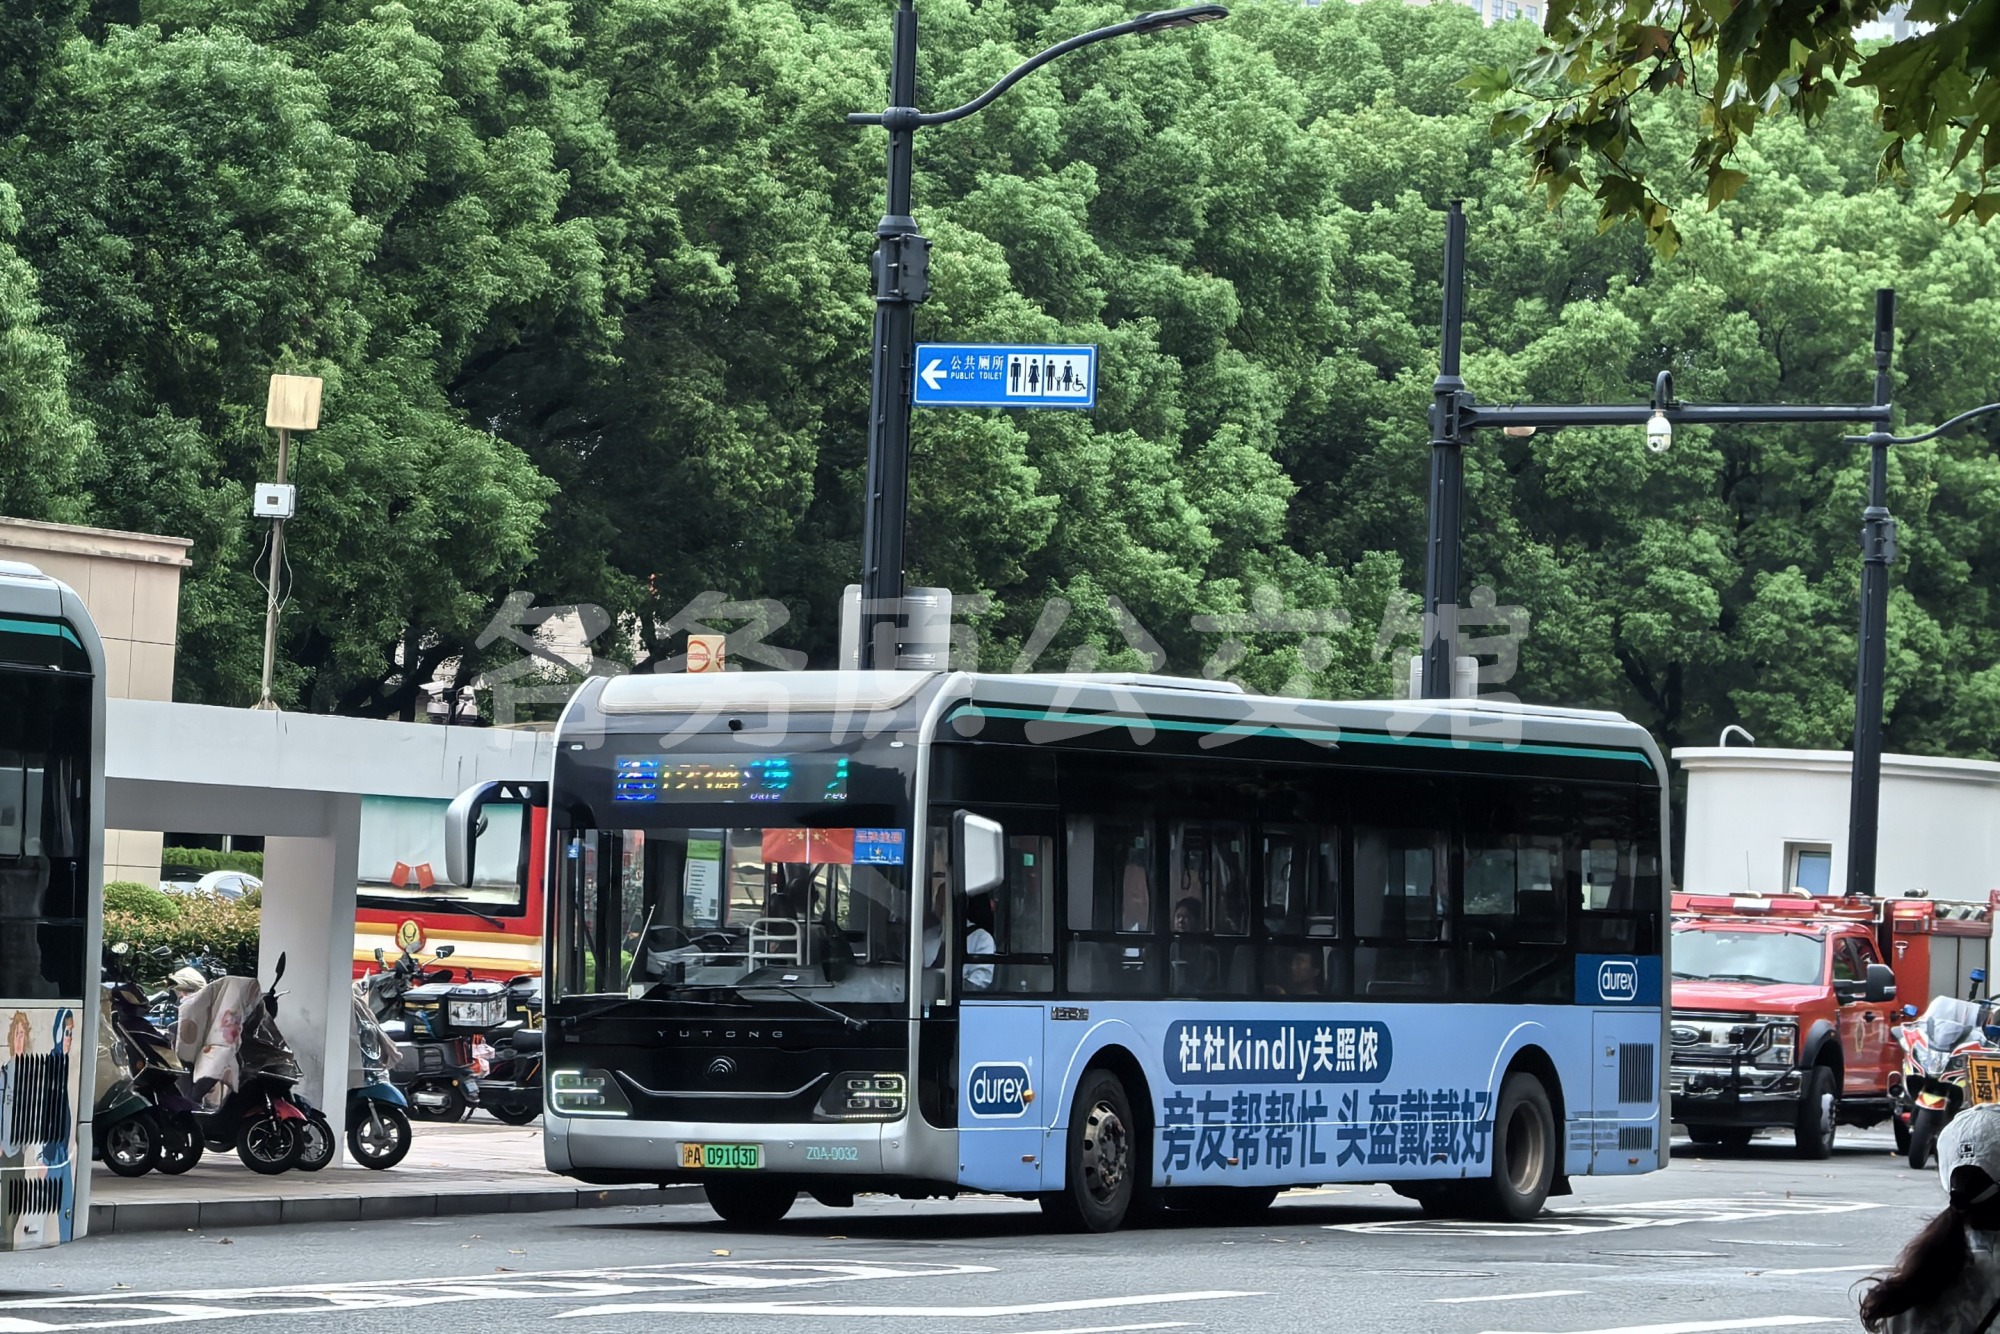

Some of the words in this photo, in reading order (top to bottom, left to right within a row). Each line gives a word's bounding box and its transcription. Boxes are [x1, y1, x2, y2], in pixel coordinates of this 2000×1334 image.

[950, 355, 1004, 370] 公共厕所
[951, 371, 975, 380] PUBLIC
[979, 371, 1002, 380] TOILET
[1602, 966, 1634, 995] durex
[657, 1030, 783, 1039] YUTONG
[1179, 1025, 1379, 1081] 杜杜kindly关照侬
[973, 1070, 1026, 1110] durex
[1162, 1089, 1329, 1173] 旁友帮帮忙
